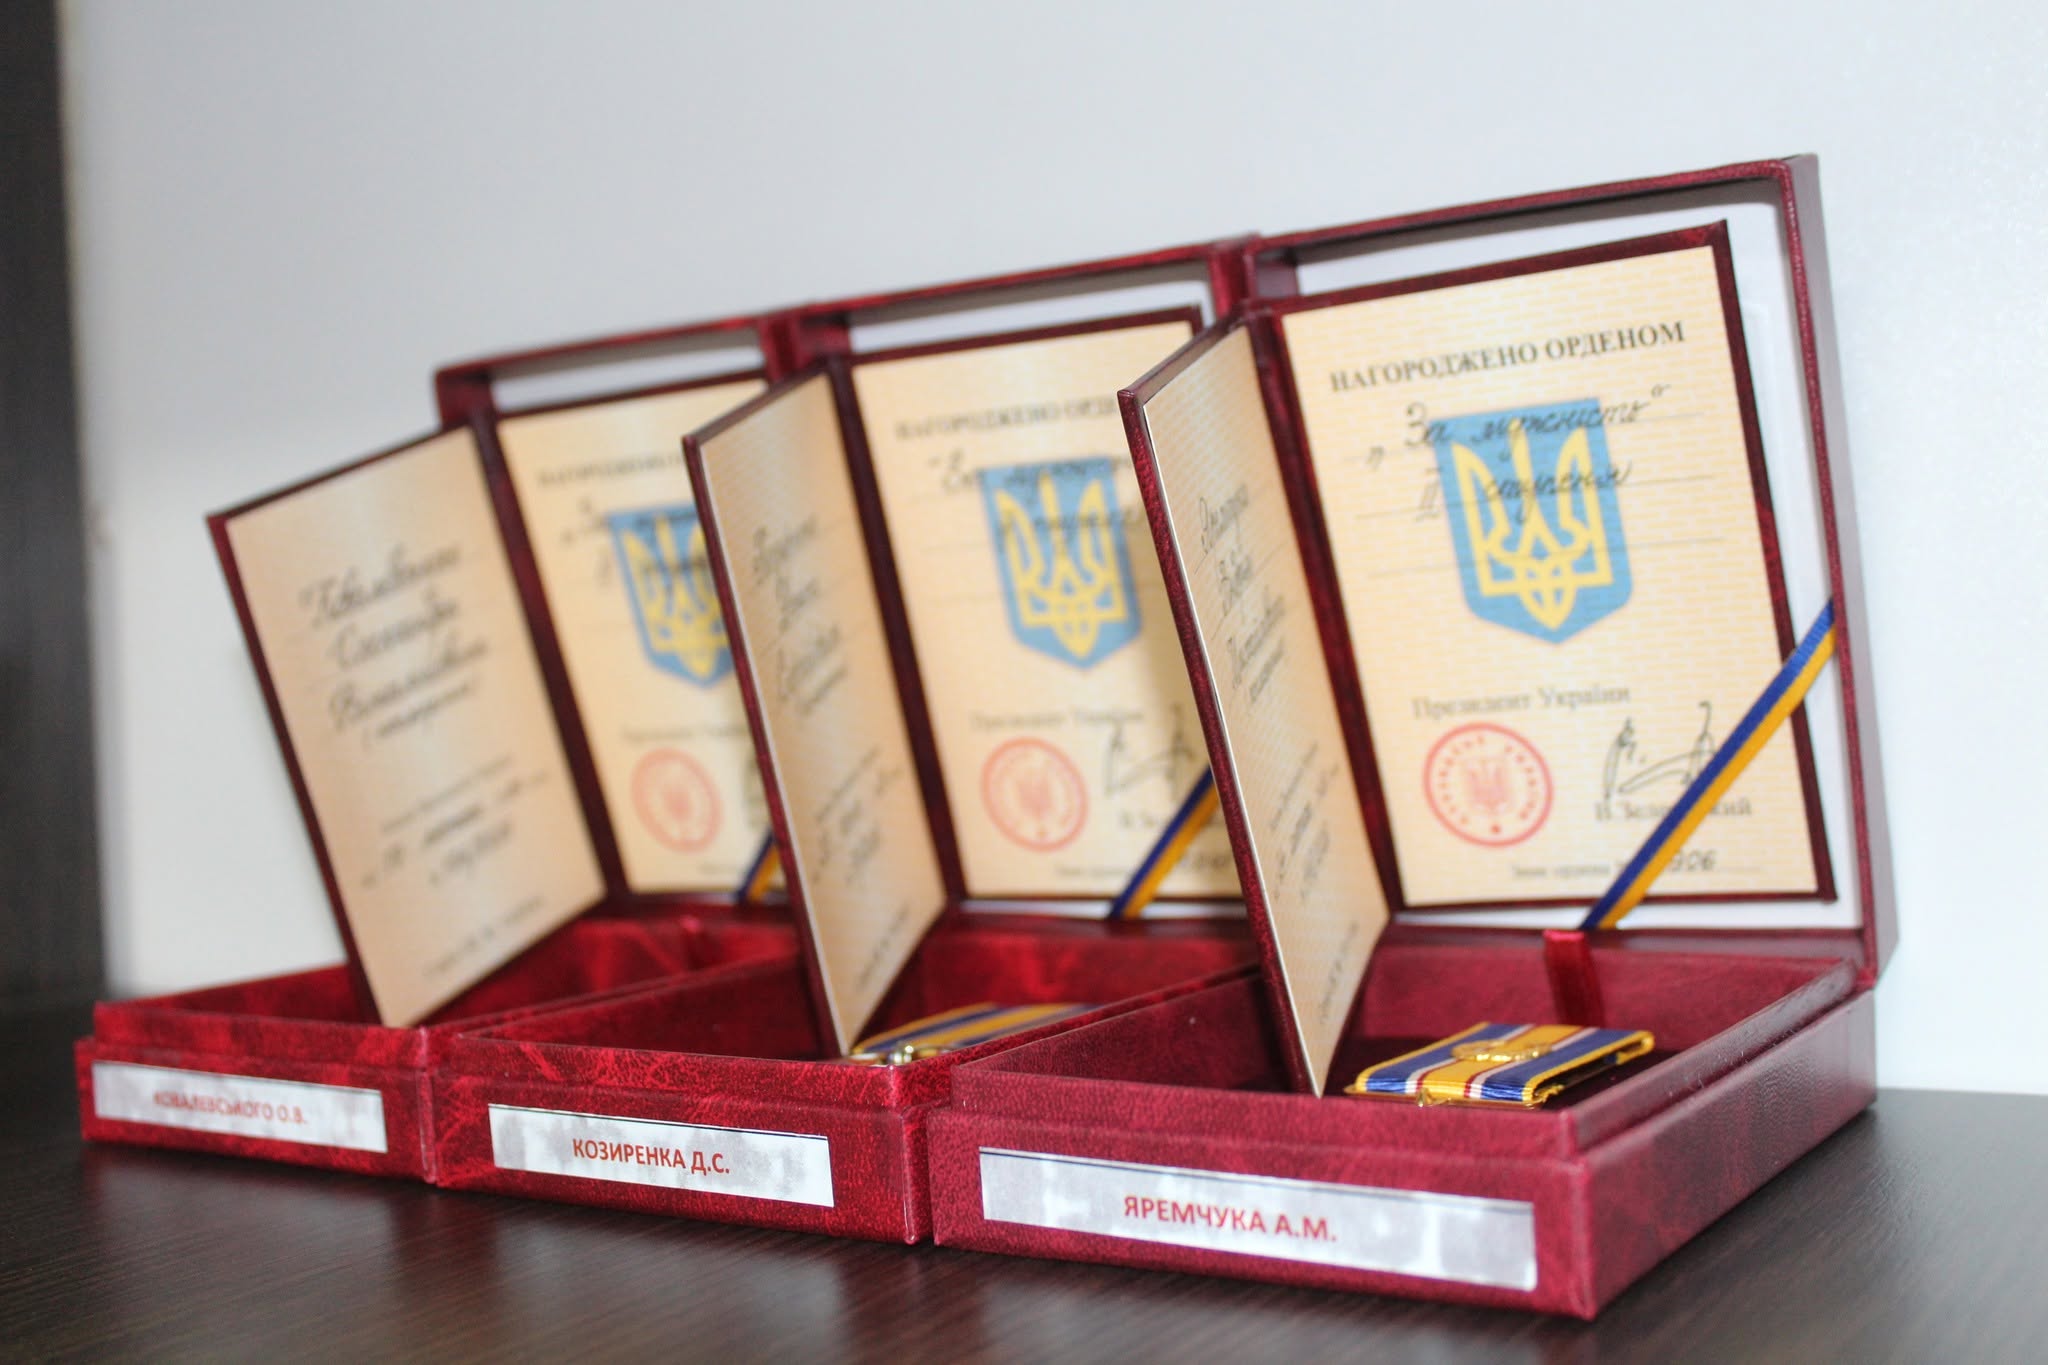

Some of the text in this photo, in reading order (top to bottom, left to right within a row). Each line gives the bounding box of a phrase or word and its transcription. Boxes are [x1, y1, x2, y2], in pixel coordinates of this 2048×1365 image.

[1330, 320, 1685, 392] НАГОРОДЖЕНО ОРДЕНОМ
[1538, 685, 1630, 710] України
[572, 1138, 730, 1176] КОЗИРЕНКА Д.С.
[1124, 1195, 1337, 1242] ЯРЕМЧУКА А.М.
